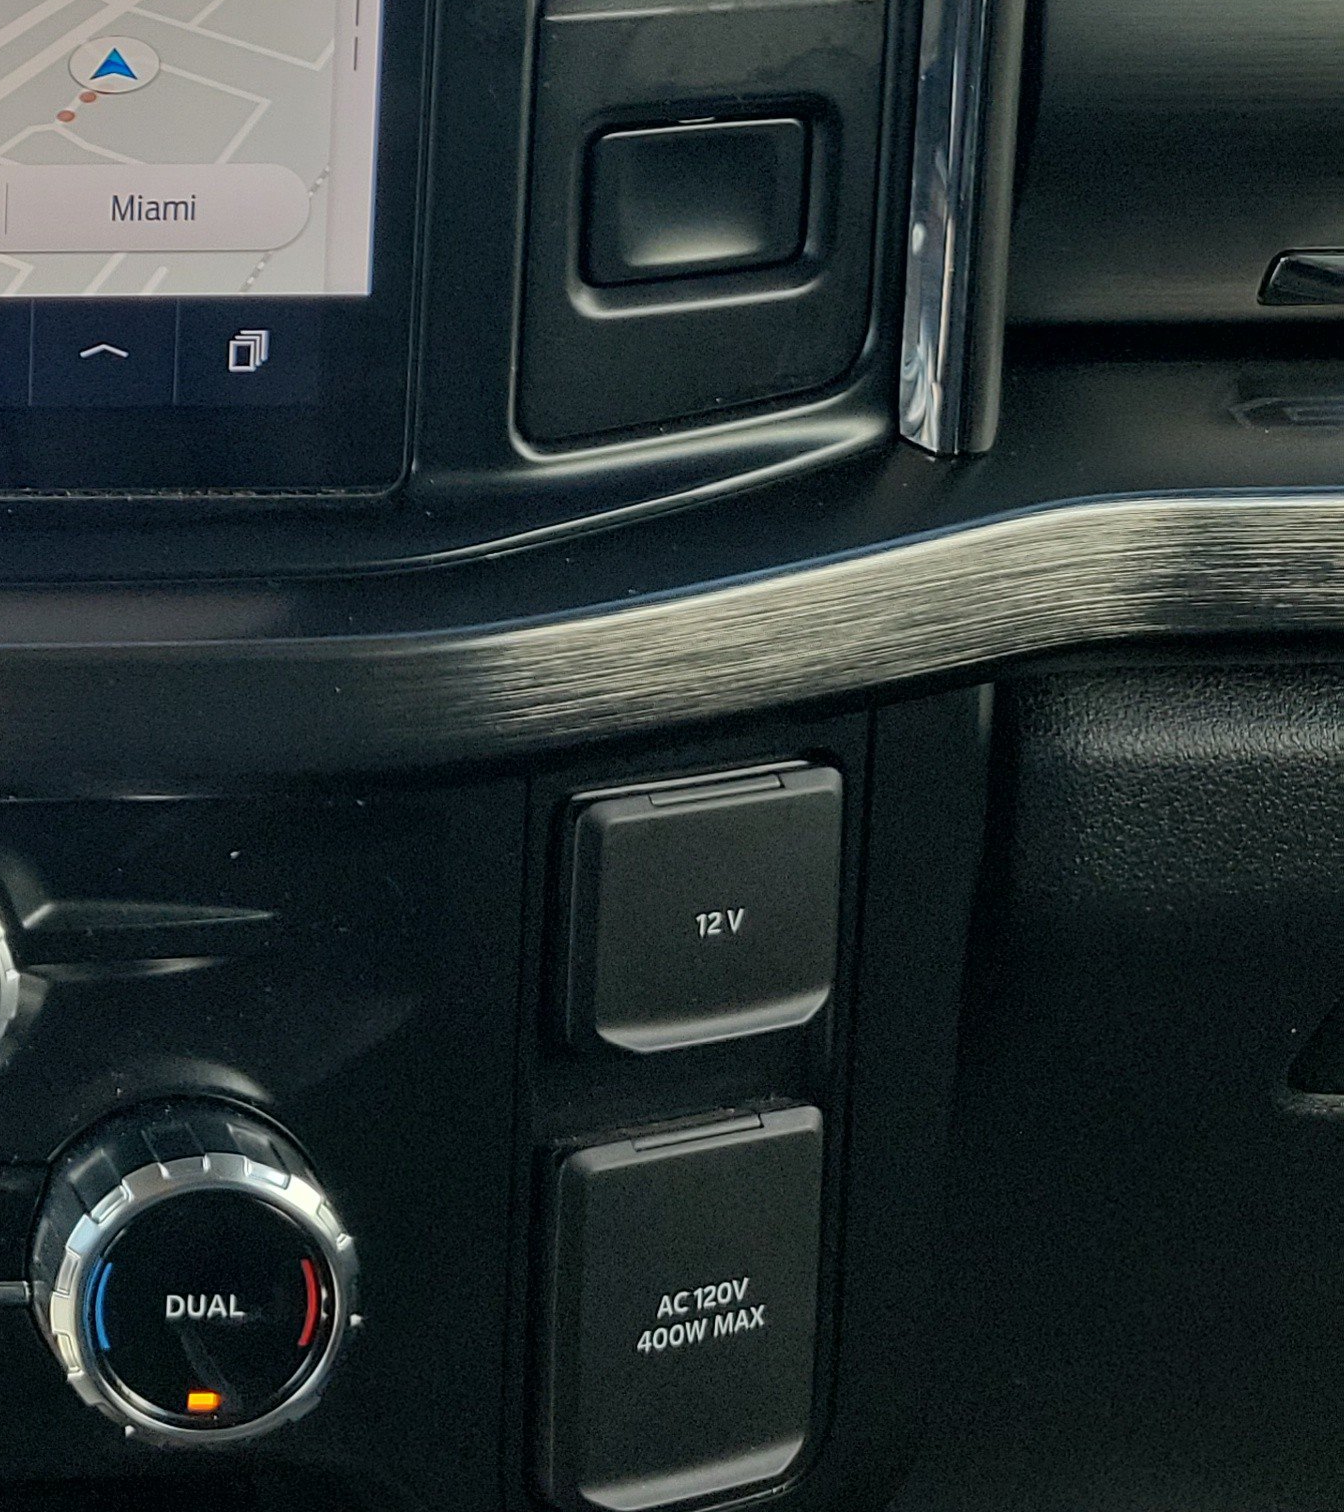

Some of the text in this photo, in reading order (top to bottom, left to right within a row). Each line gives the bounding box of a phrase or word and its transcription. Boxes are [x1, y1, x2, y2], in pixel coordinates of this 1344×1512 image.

[112, 194, 196, 222] Miami
[696, 907, 746, 939] 12 V
[165, 1293, 246, 1320] DUAL
[657, 1277, 749, 1320] AC 120V
[637, 1304, 766, 1354] 400W MAX
